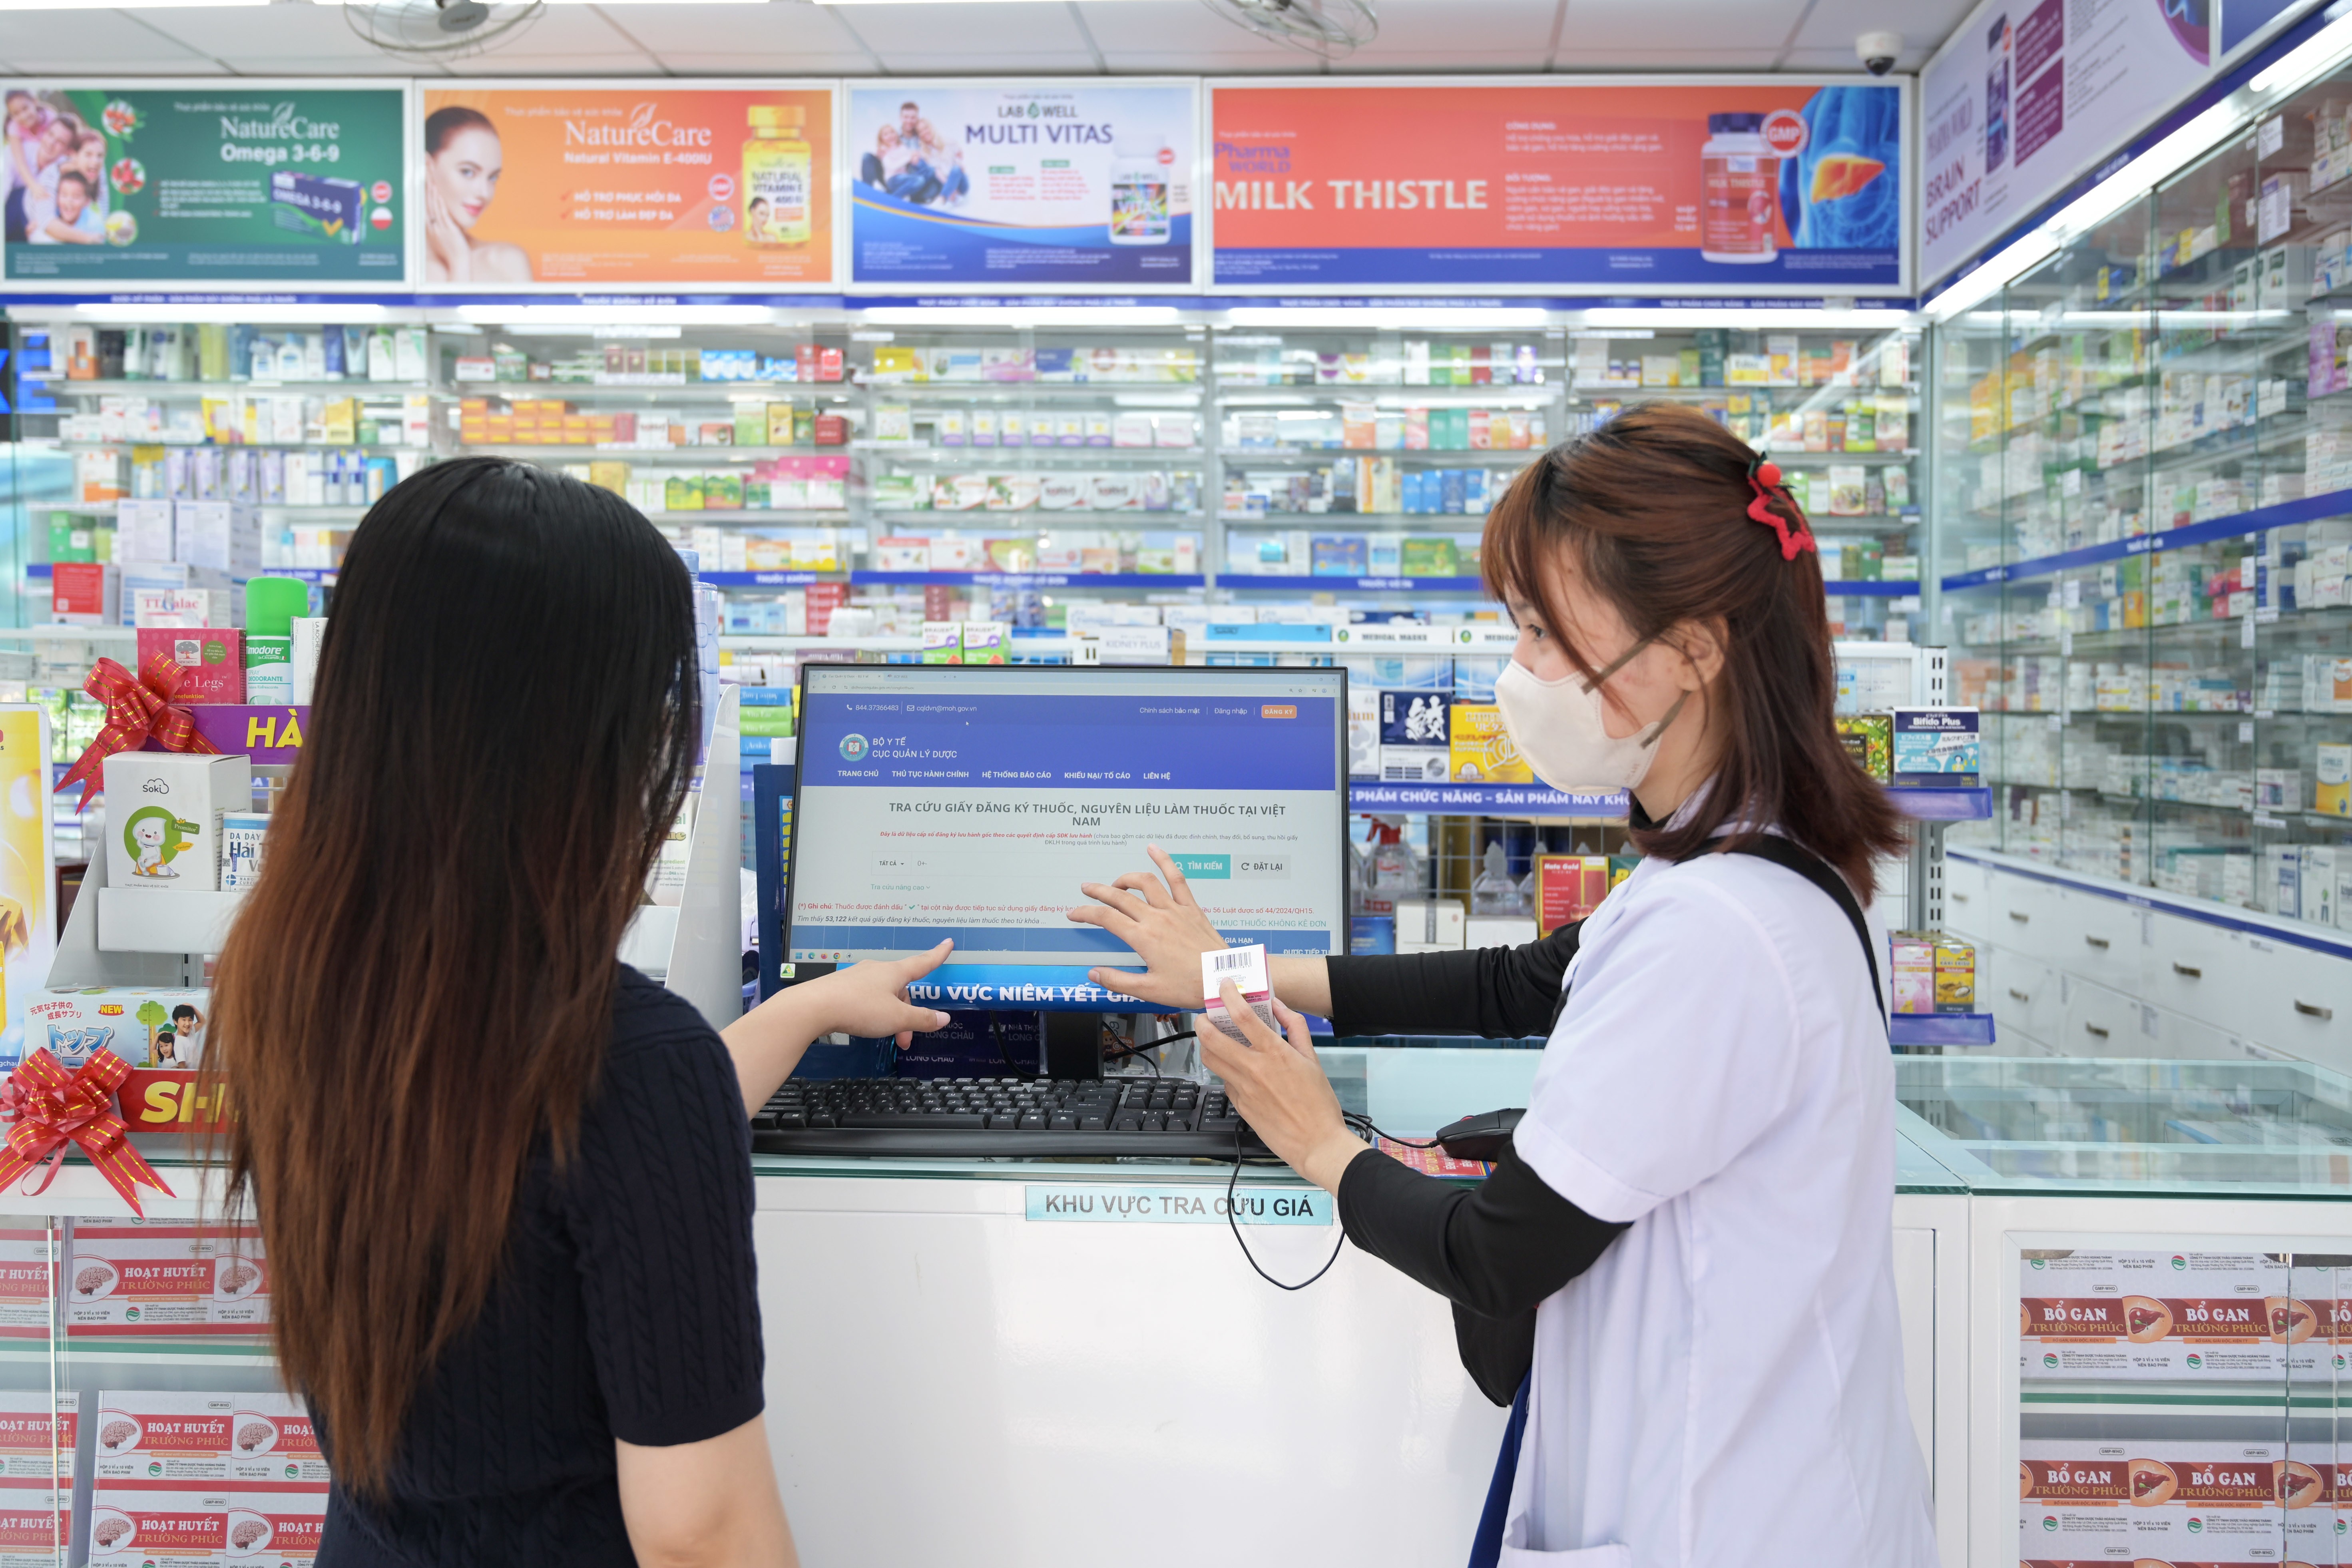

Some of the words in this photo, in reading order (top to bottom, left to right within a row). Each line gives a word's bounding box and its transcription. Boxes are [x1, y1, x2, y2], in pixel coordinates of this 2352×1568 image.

[998, 106, 1024, 118] LAB
[1043, 106, 1078, 118] WELL
[220, 116, 340, 139] NatureCare
[564, 121, 712, 146] NatureCare
[965, 124, 1038, 144] MULTI
[1046, 124, 1113, 144] VITAS
[1768, 127, 1800, 142] GMP
[220, 143, 288, 165] Omega
[292, 143, 340, 162] 3-6-9
[564, 152, 610, 164] Natural
[613, 152, 660, 164] Vitamin
[1214, 142, 1290, 159] Pharma
[1229, 161, 1291, 173] WORLD
[1926, 156, 1965, 209] BRAIN
[1214, 181, 1314, 210] MILK
[1327, 180, 1488, 210] THISTLE
[1926, 178, 1982, 245] SUPPORT
[872, 737, 885, 747] BỘ
[895, 736, 906, 745] TẾ
[872, 750, 890, 759] CỤC
[892, 748, 917, 758] QUẢN
[920, 749, 930, 758] LÝ
[932, 750, 957, 759] DƯỢC
[982, 770, 992, 779] HỆ
[1161, 772, 1171, 781] HỆ
[1400, 787, 1438, 803] CHỨC
[1442, 787, 1482, 804] NĂNG
[1496, 789, 1524, 804] SẢN
[1528, 790, 1568, 804] PHẨM
[889, 803, 912, 812] TRA
[915, 801, 941, 812] CỨU
[945, 801, 973, 812] GIẤY
[976, 801, 1010, 813] ĐĂNG
[1015, 801, 1029, 813] KÝ
[1032, 801, 1077, 815] THUỐC,
[1081, 803, 1131, 814] NGUYÊN
[1135, 803, 1160, 816] LIỆU
[1165, 803, 1189, 814] LÀM
[1193, 803, 1235, 815] THUỐC
[1238, 806, 1257, 817] TẠI
[1260, 804, 1286, 817] VIỆT
[1072, 817, 1100, 826] NAM
[230, 833, 240, 841] DẠ
[245, 831, 261, 840] DÀY
[1187, 861, 1202, 870] TÌM
[1203, 861, 1223, 870] KIẾM
[1253, 861, 1269, 871] ĐẶT
[1271, 863, 1283, 872] LẠI
[1240, 918, 1267, 926] THUỐC
[1269, 918, 1296, 927] KHÔNG
[947, 983, 993, 1003] VỰC
[1000, 983, 1054, 1001] NIÊM
[1058, 982, 1101, 1002] YẾT
[30, 1001, 73, 1016] 元気な子供の
[47, 1010, 82, 1020] 成長サプリ
[100, 1005, 122, 1014] NEW
[47, 1024, 112, 1054] トップ
[1046, 1194, 1093, 1213] KHU
[1101, 1195, 1151, 1218] VỰC
[1159, 1196, 1206, 1215] TRA
[1213, 1193, 1265, 1216] CỨU
[1273, 1194, 1314, 1217] GIÁ
[125, 1267, 160, 1279] HOẠT
[163, 1263, 206, 1277] HUYẾT
[120, 1279, 174, 1290] TRƯỜNG
[177, 1278, 210, 1289] PHÚC
[2043, 1300, 2066, 1321] BỔ
[2070, 1308, 2107, 1321] GAN
[2031, 1321, 2086, 1332] TRƯỜNG
[2089, 1322, 2124, 1332] PHÚC
[147, 1423, 181, 1435] HOẠT
[183, 1419, 225, 1434] HUYẾT
[143, 1435, 193, 1445] TRƯỜNG
[197, 1436, 229, 1446] PHÚC
